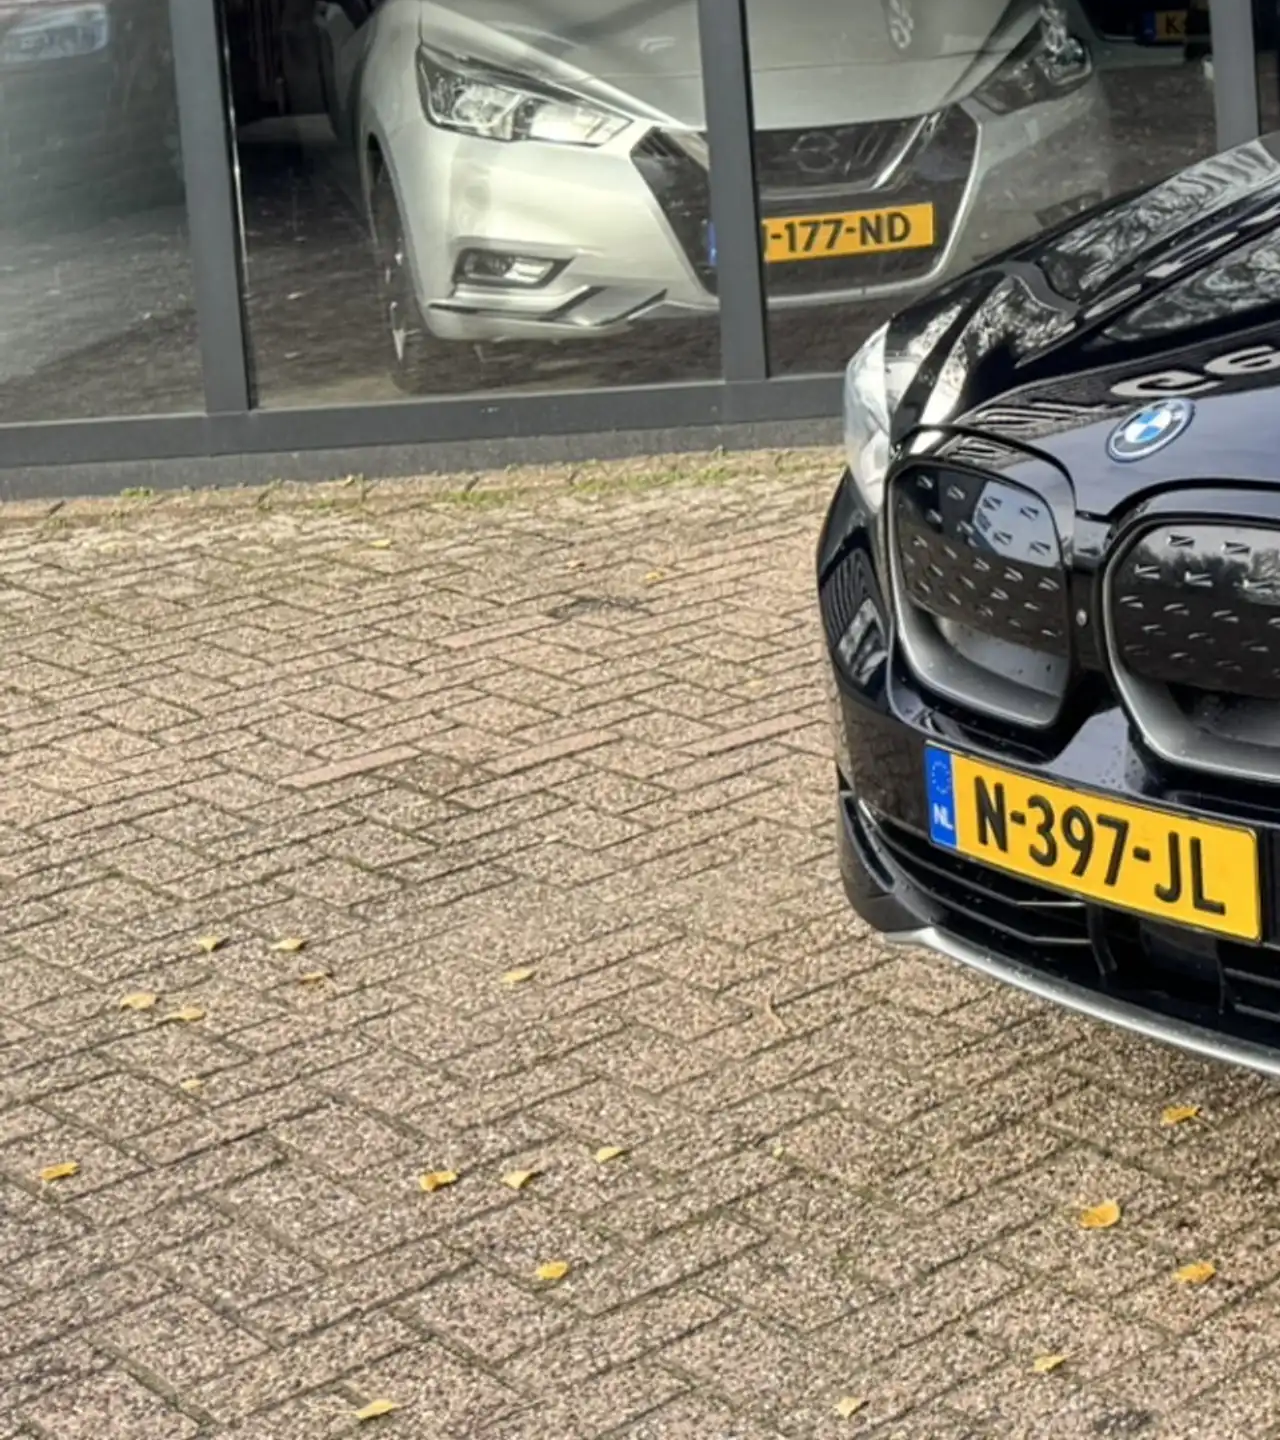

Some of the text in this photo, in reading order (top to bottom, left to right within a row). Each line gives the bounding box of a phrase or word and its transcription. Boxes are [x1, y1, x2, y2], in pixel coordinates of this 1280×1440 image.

[762, 211, 911, 256] -177-ND
[933, 802, 953, 830] NL
[973, 775, 1227, 916] N-397-JL
